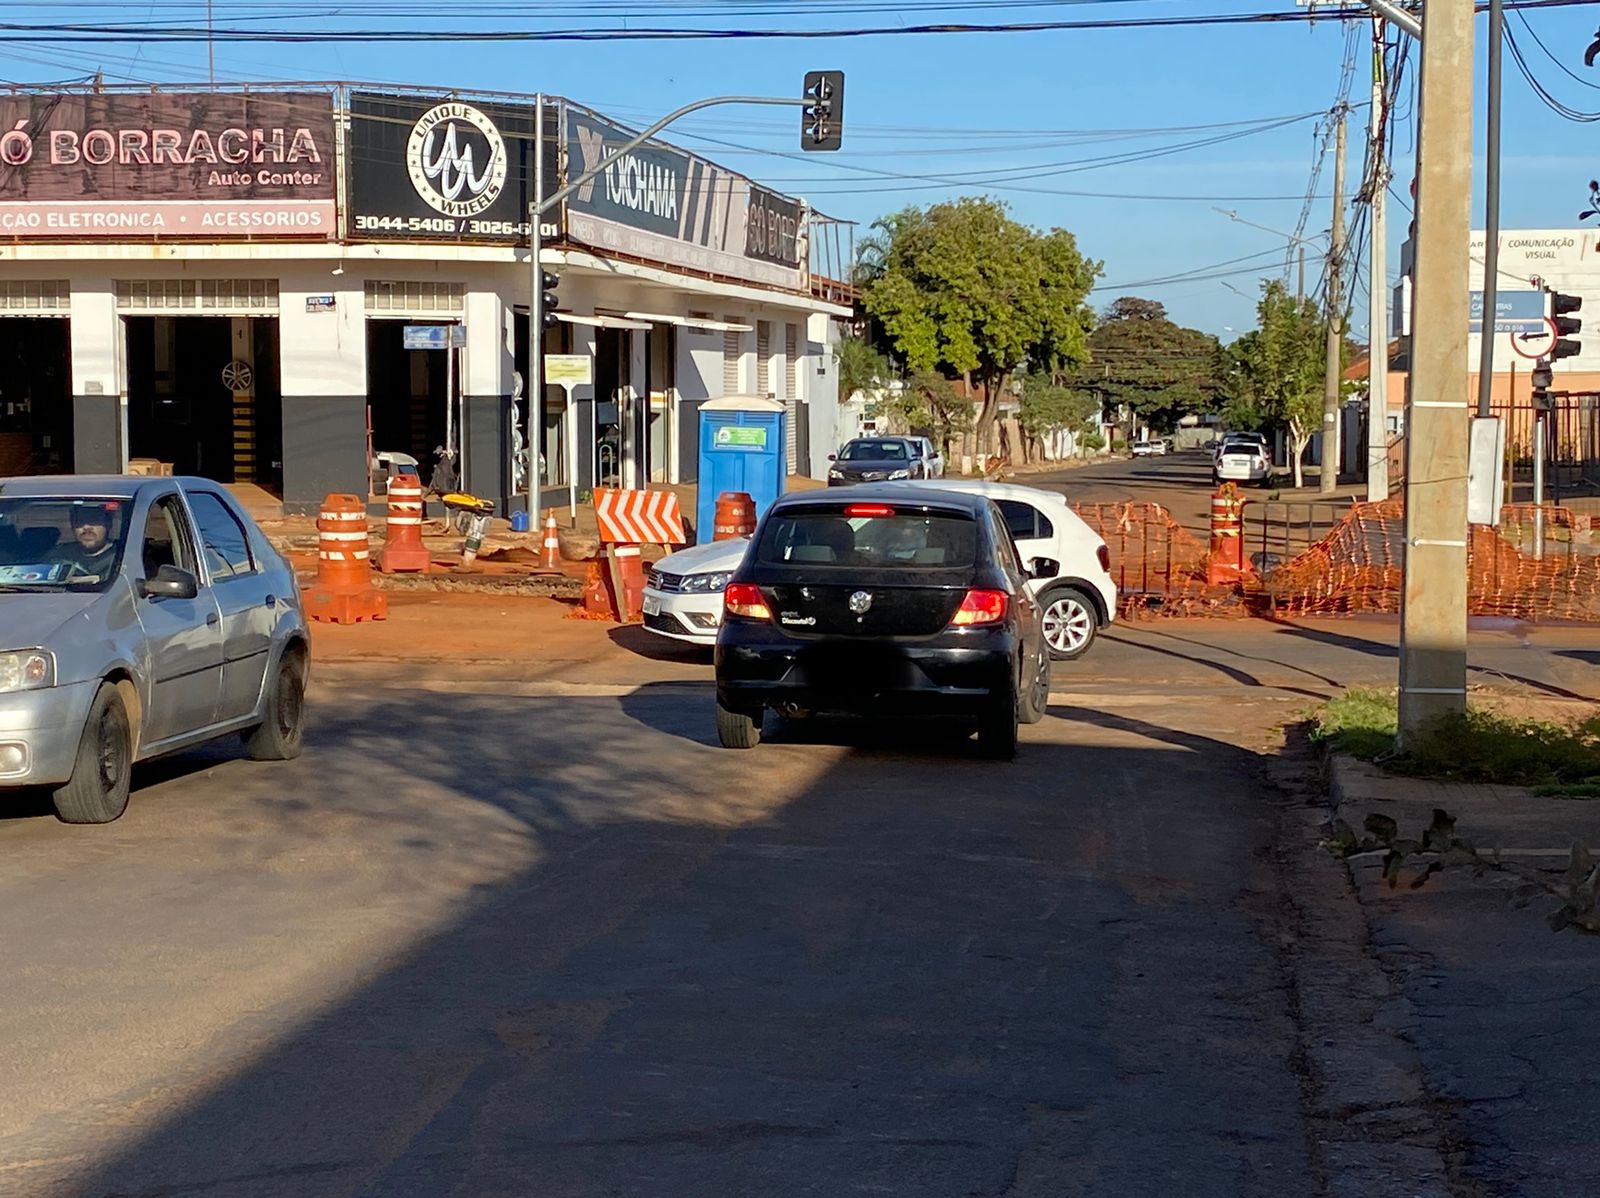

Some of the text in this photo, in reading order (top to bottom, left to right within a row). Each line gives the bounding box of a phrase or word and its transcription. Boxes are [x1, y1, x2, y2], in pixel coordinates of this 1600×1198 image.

[415, 105, 472, 138] UNIQUE
[50, 128, 321, 165] BORRACHA
[208, 170, 322, 186] Auto Center
[602, 144, 678, 221] YOKOHAMA
[441, 183, 500, 216] WHEELS
[47, 212, 165, 228] ELETRONICA
[201, 211, 322, 227] ACESSORIOS
[355, 215, 456, 233] 3044-5406
[469, 220, 558, 237] 3026-601
[1508, 238, 1575, 250] COMUNICAÇÃO
[1525, 251, 1556, 259] VISUAL
